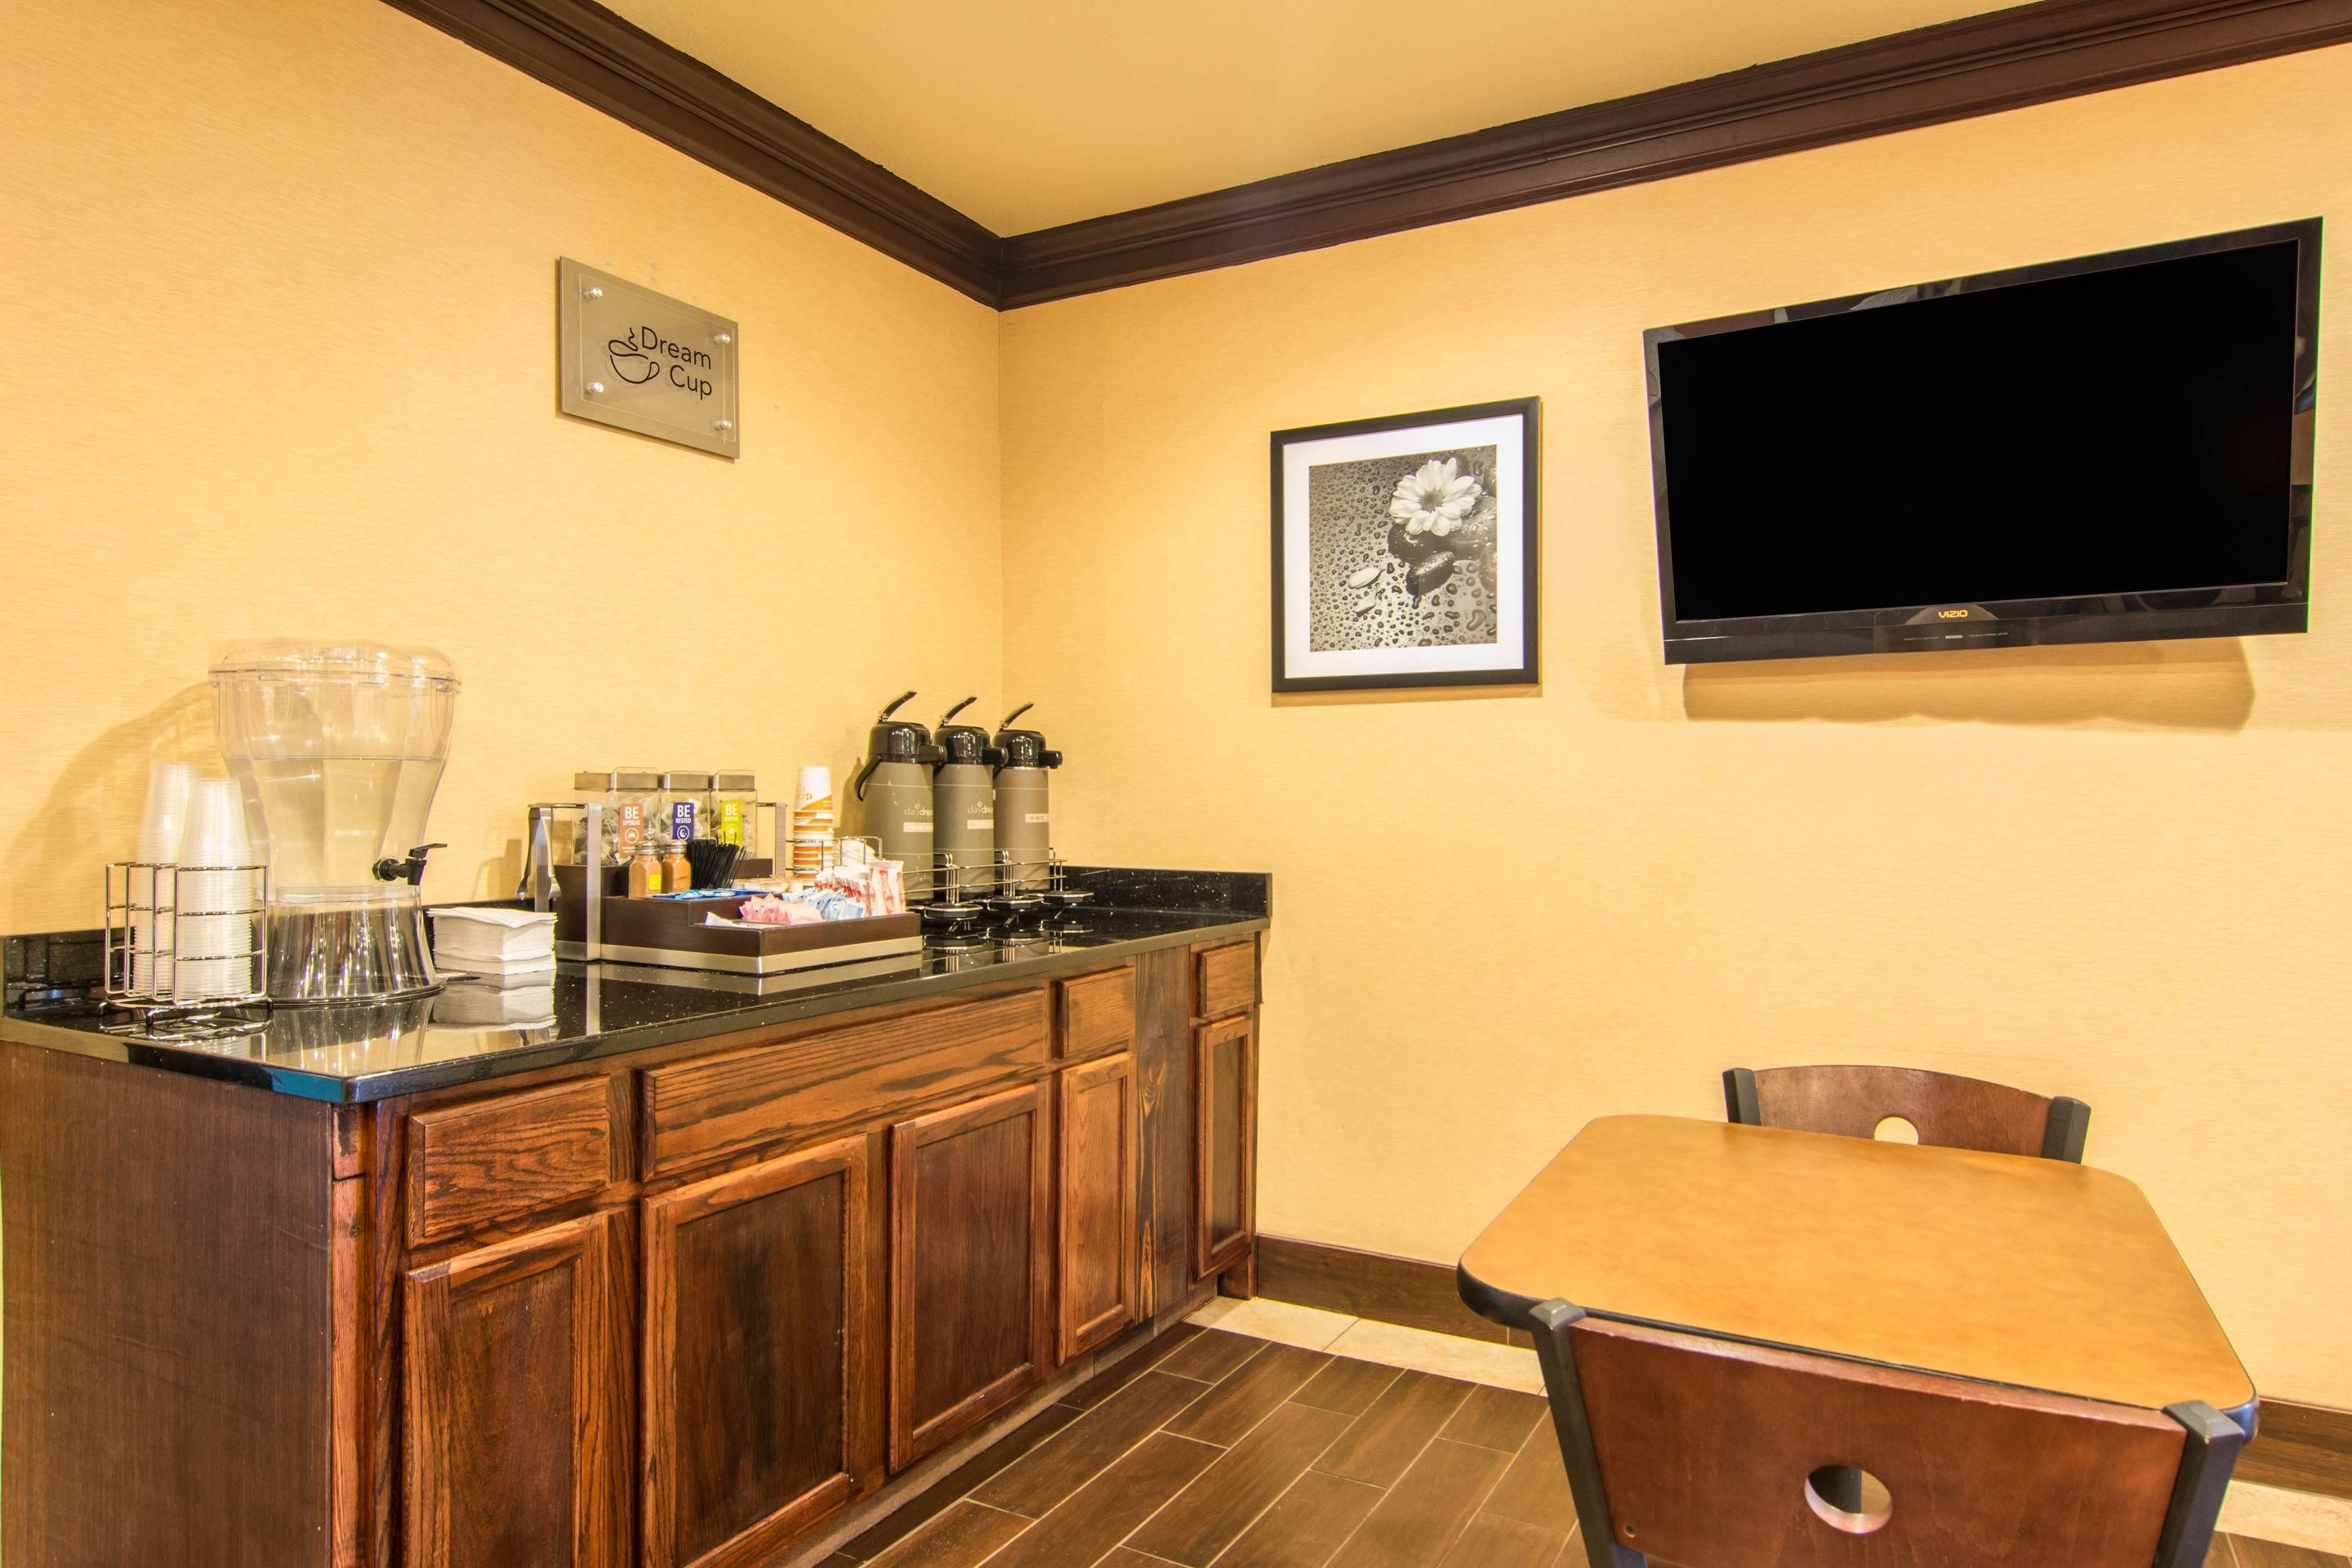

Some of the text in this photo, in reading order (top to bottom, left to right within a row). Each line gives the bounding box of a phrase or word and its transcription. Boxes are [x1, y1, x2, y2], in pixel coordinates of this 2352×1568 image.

[641, 326, 711, 370] Dream
[670, 364, 712, 400] Cup
[1939, 609, 1968, 618] VIZIO
[625, 806, 639, 819] BE
[677, 804, 691, 817] BE
[725, 804, 738, 816] BE
